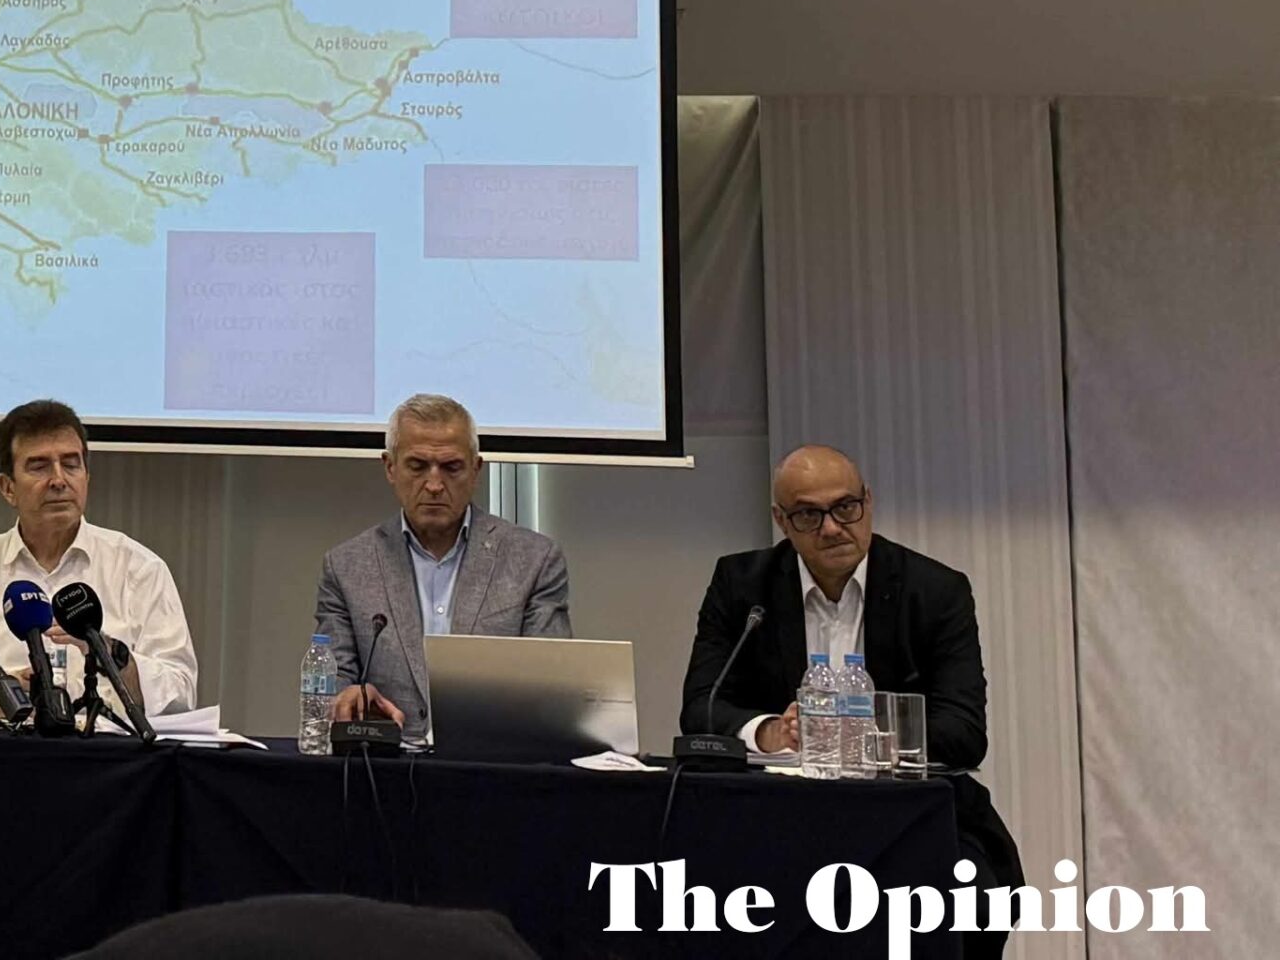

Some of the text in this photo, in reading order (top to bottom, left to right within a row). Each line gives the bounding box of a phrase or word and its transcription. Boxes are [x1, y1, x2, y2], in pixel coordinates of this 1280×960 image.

[101, 72, 174, 88] Προφήτης
[403, 70, 500, 86] Ασπροβάλτα
[400, 102, 463, 119] Σταυρός
[185, 124, 213, 138] Νέα
[146, 170, 225, 186] Ζαγκλιβέρι
[35, 253, 99, 268] Βασιλικά
